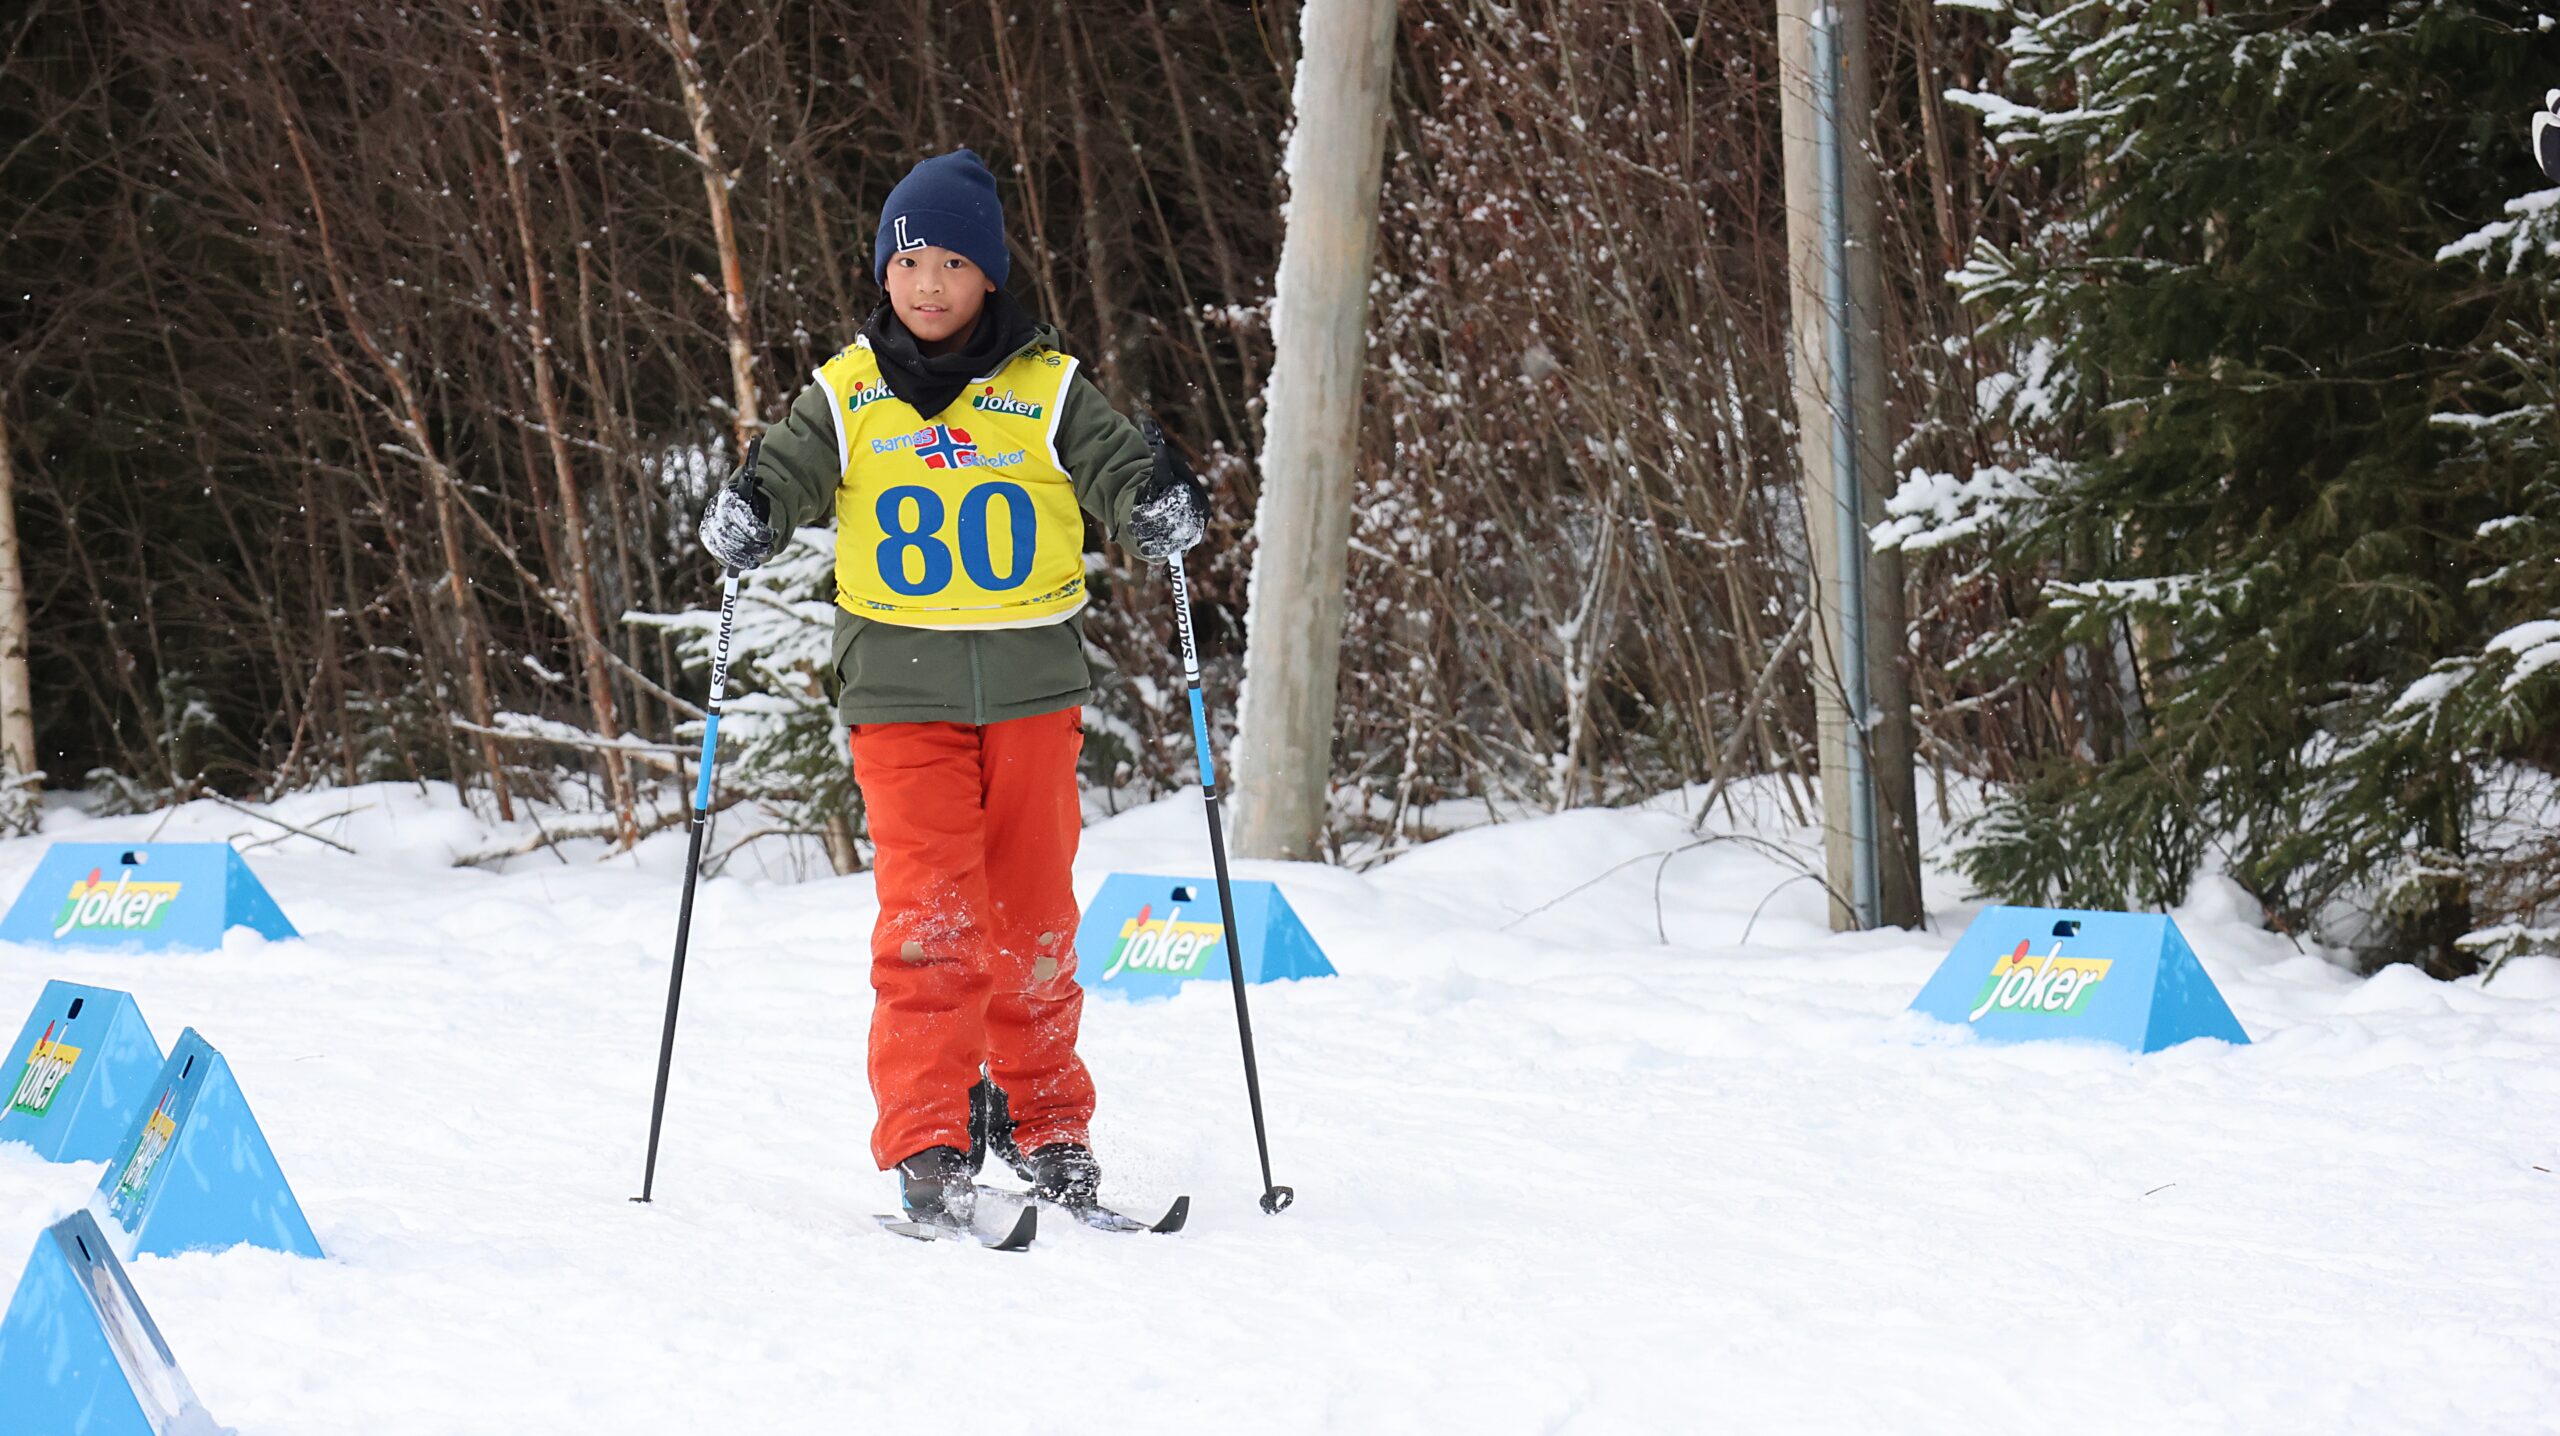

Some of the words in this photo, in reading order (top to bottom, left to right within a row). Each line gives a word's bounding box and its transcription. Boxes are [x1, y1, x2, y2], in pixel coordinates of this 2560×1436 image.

[894, 216, 927, 253] L
[852, 376, 895, 413] jok
[975, 386, 1040, 416] joker
[871, 429, 933, 454] Barnas
[961, 449, 1026, 468] skeker
[875, 481, 1037, 596] 80
[713, 594, 735, 687] SALOMON
[1169, 564, 1193, 660] SALOMON
[53, 867, 169, 940] joker
[1102, 904, 1217, 982] joker
[1968, 938, 2099, 1023] joker
[0, 1019, 74, 1121] joker
